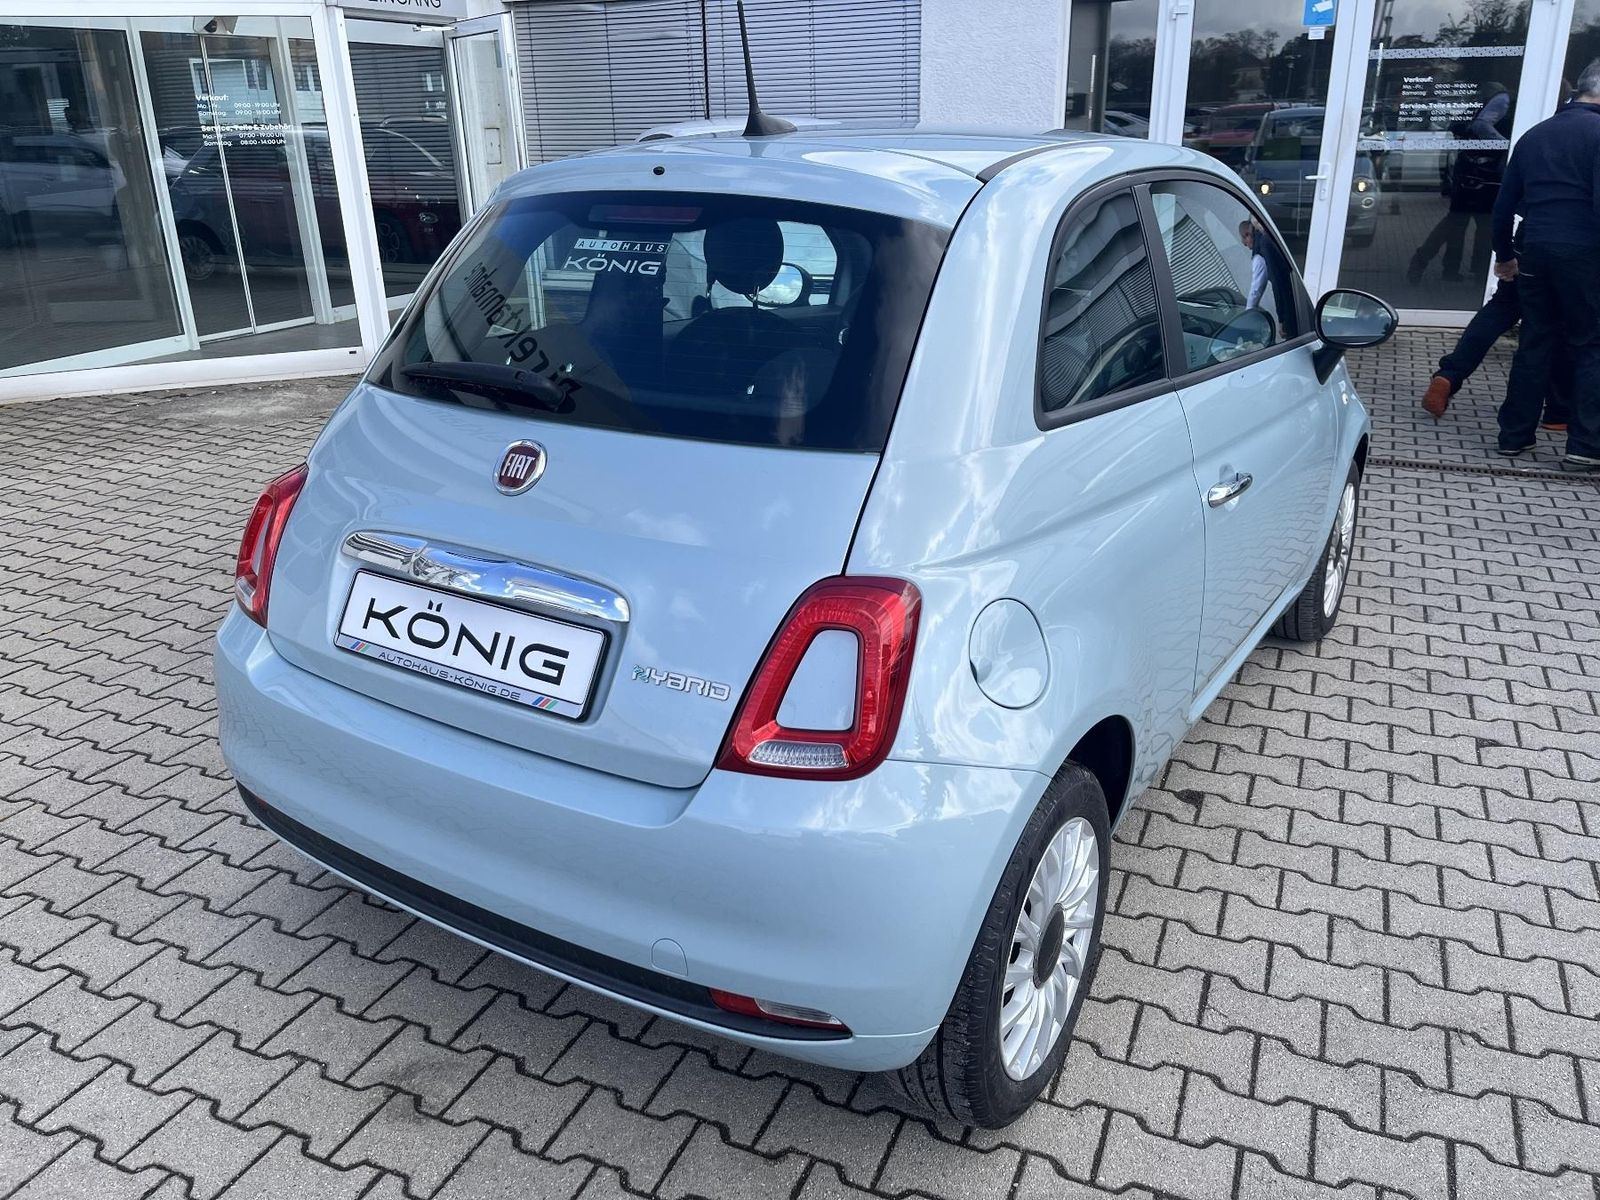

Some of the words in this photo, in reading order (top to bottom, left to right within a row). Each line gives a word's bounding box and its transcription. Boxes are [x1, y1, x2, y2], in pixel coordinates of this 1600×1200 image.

[578, 239, 666, 254] AUTOHAUS
[563, 252, 662, 276] KÖNIG
[501, 453, 536, 479] FIAT
[362, 597, 570, 686] KÖNIG
[631, 664, 732, 702] HYBRID
